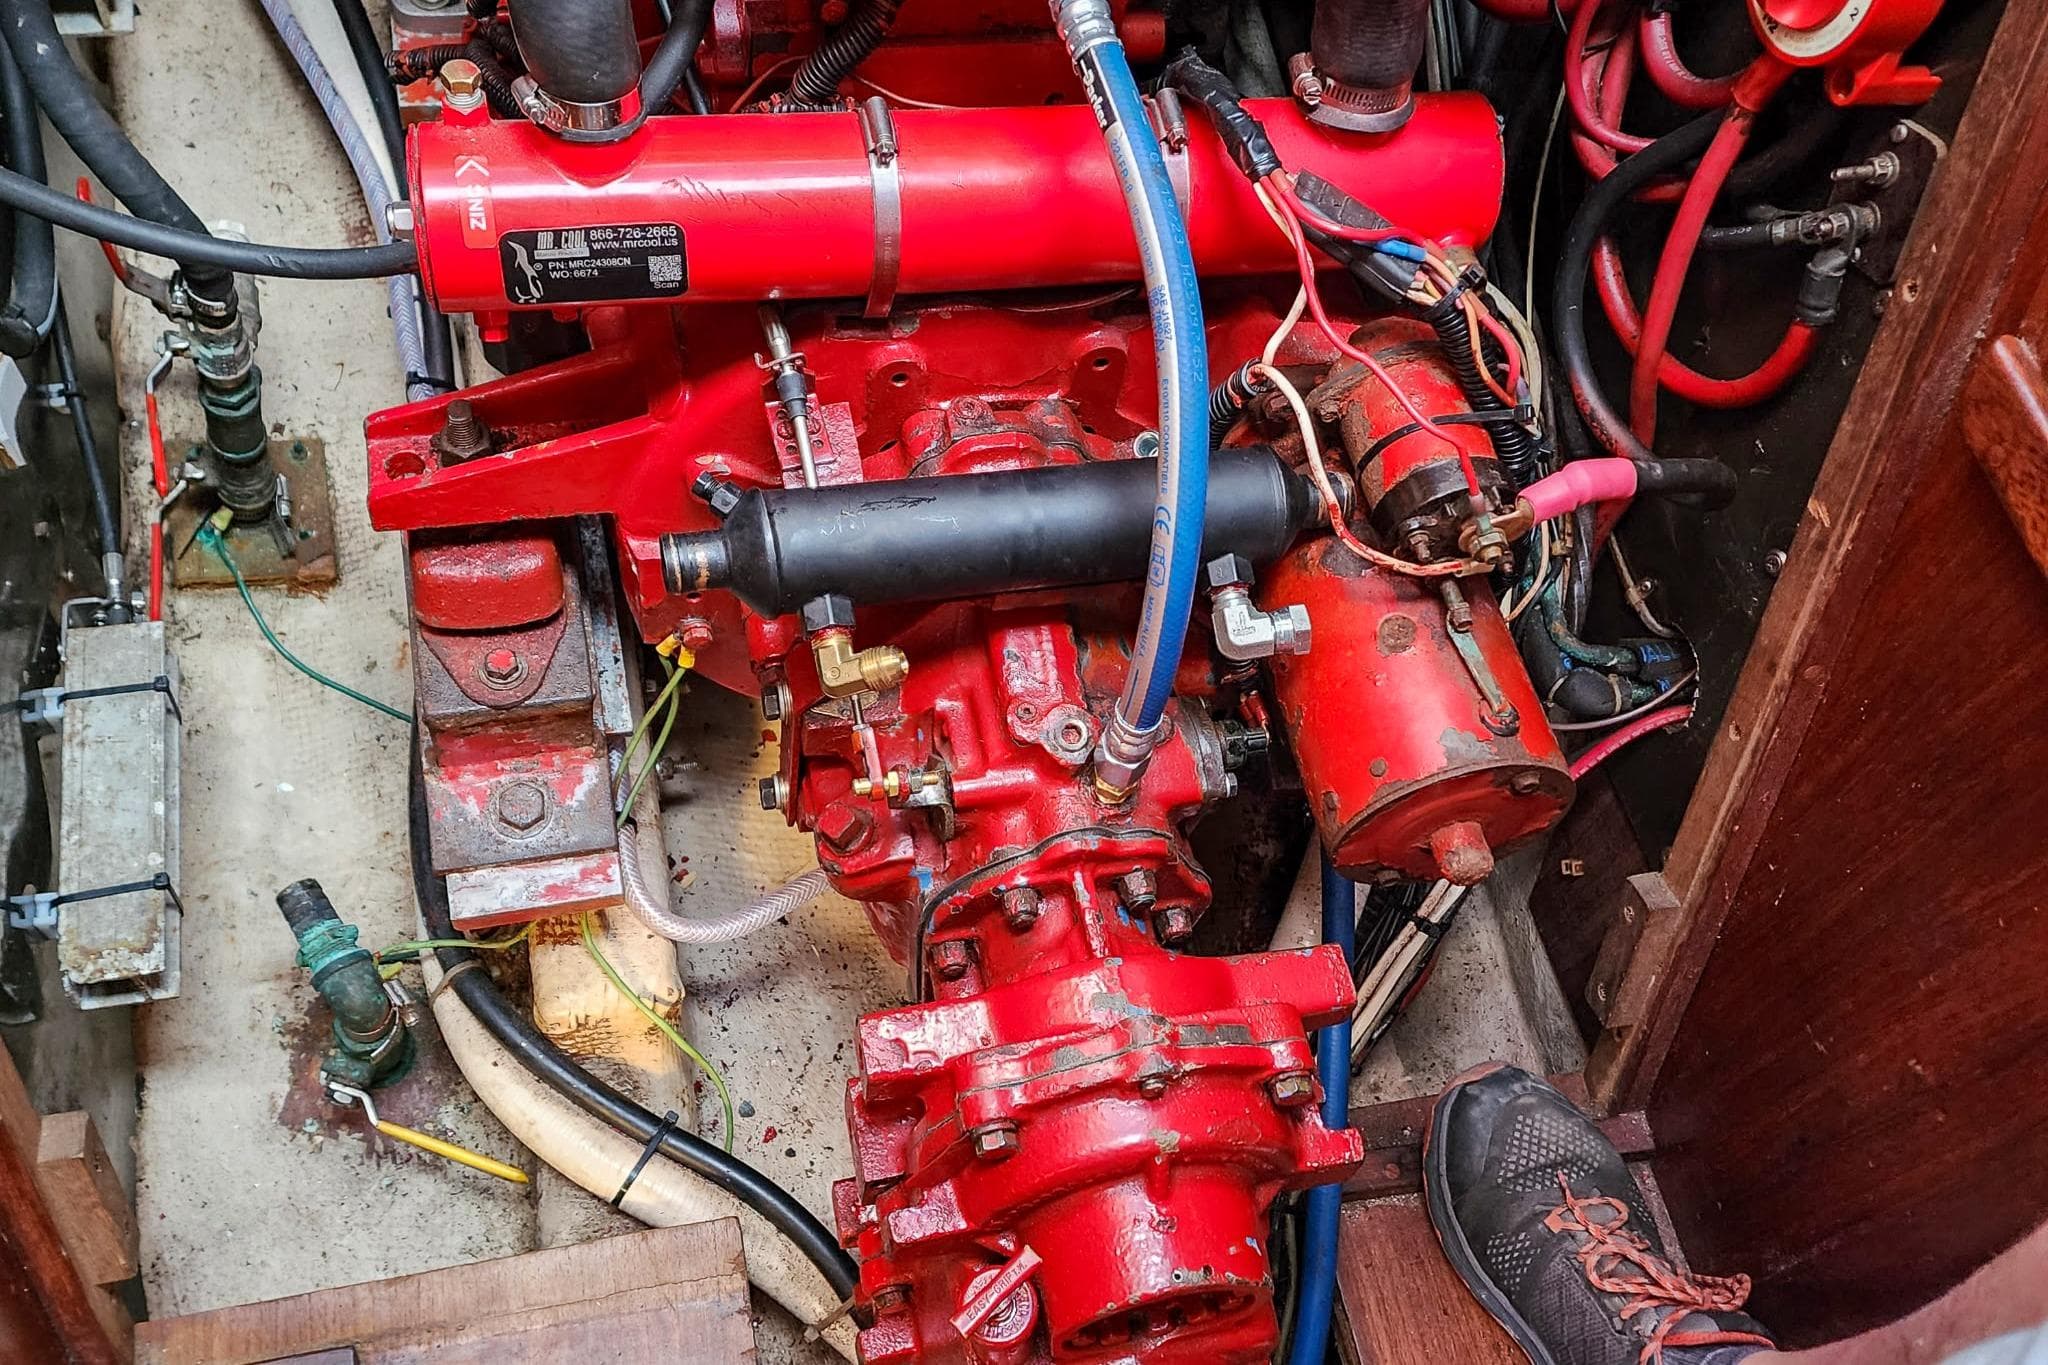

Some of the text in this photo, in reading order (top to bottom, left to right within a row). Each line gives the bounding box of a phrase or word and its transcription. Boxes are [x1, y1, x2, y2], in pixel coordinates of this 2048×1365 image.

[1849, 7, 1860, 22] 2
[1080, 59, 1107, 128] Parker
[561, 229, 588, 249] COOL
[590, 226, 677, 241] 866-726-2665
[592, 237, 679, 250] www.mrcool.us
[653, 281, 679, 289] Scan
[1157, 284, 1168, 307] SAE
[1161, 424, 1170, 494] COMPATIBLE
[966, 1271, 1014, 1321] EASY-GRIP
